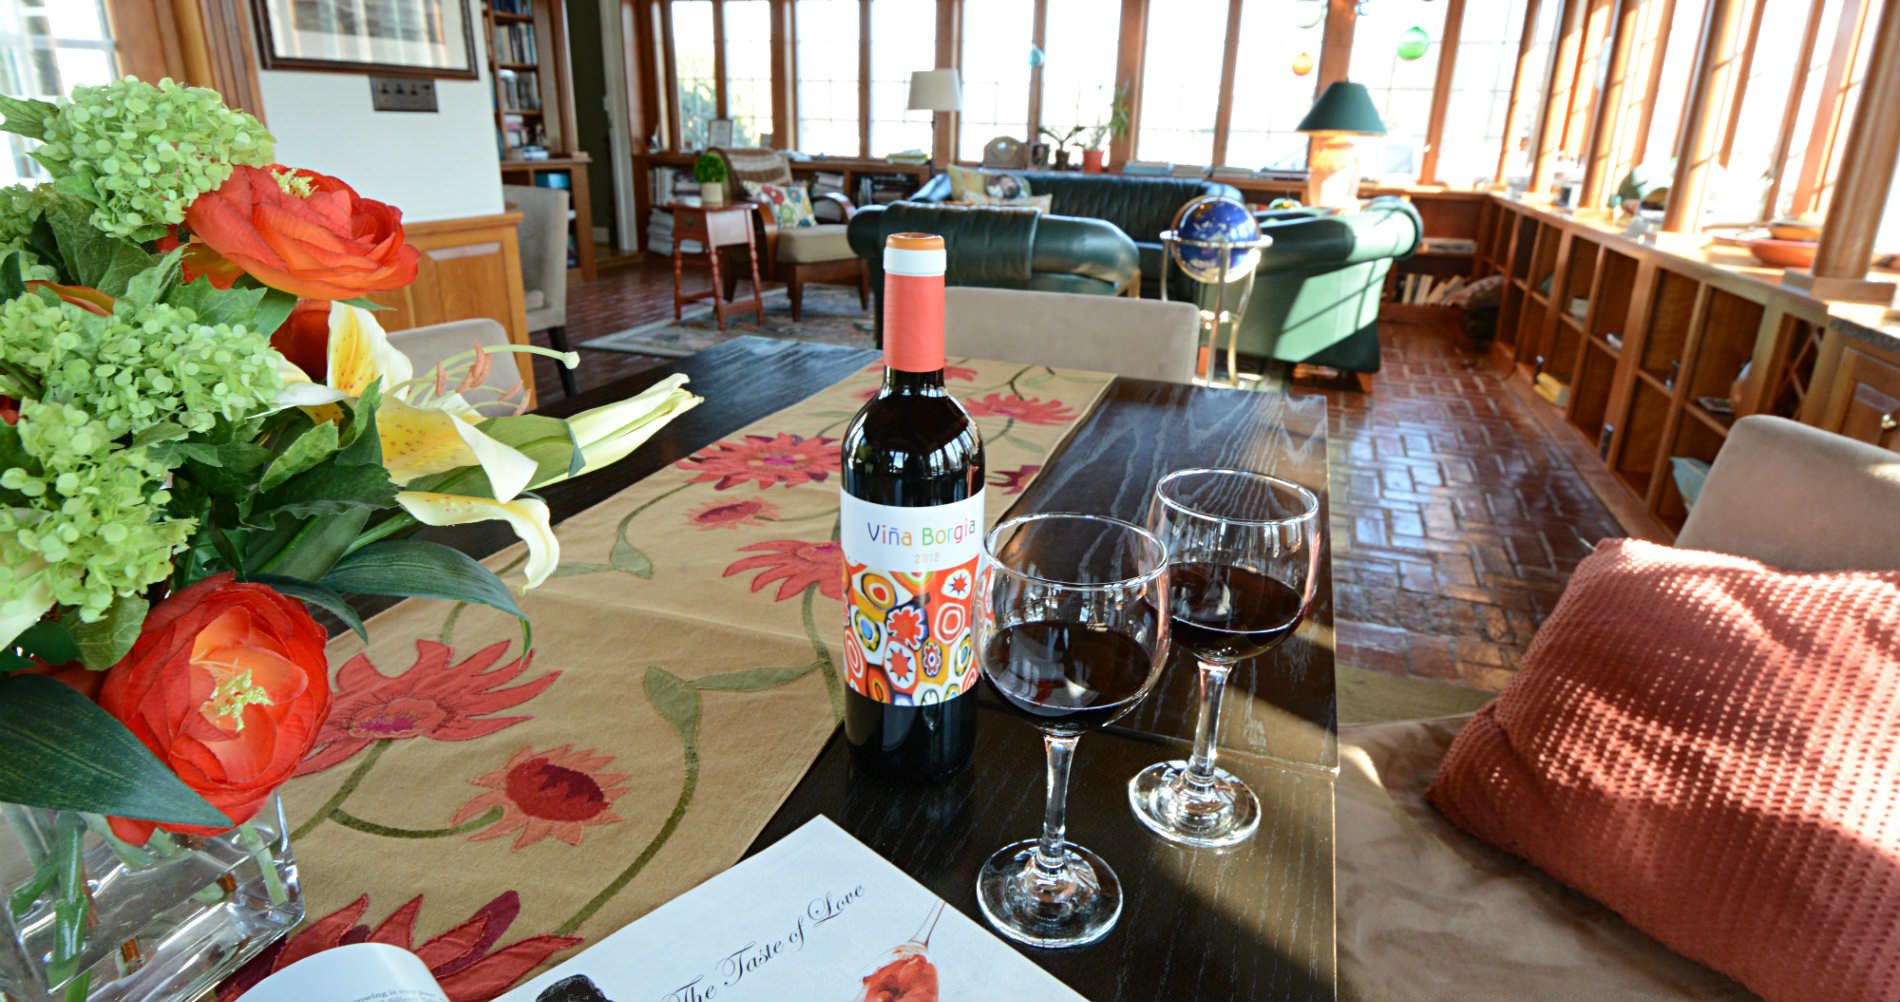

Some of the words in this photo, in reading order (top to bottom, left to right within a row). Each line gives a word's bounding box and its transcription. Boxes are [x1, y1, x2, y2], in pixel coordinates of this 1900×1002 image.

[867, 521, 913, 547] Viña
[921, 517, 976, 546] Borgia
[716, 941, 784, 987] Taste
[788, 915, 805, 952] of
[806, 884, 865, 928] Love
